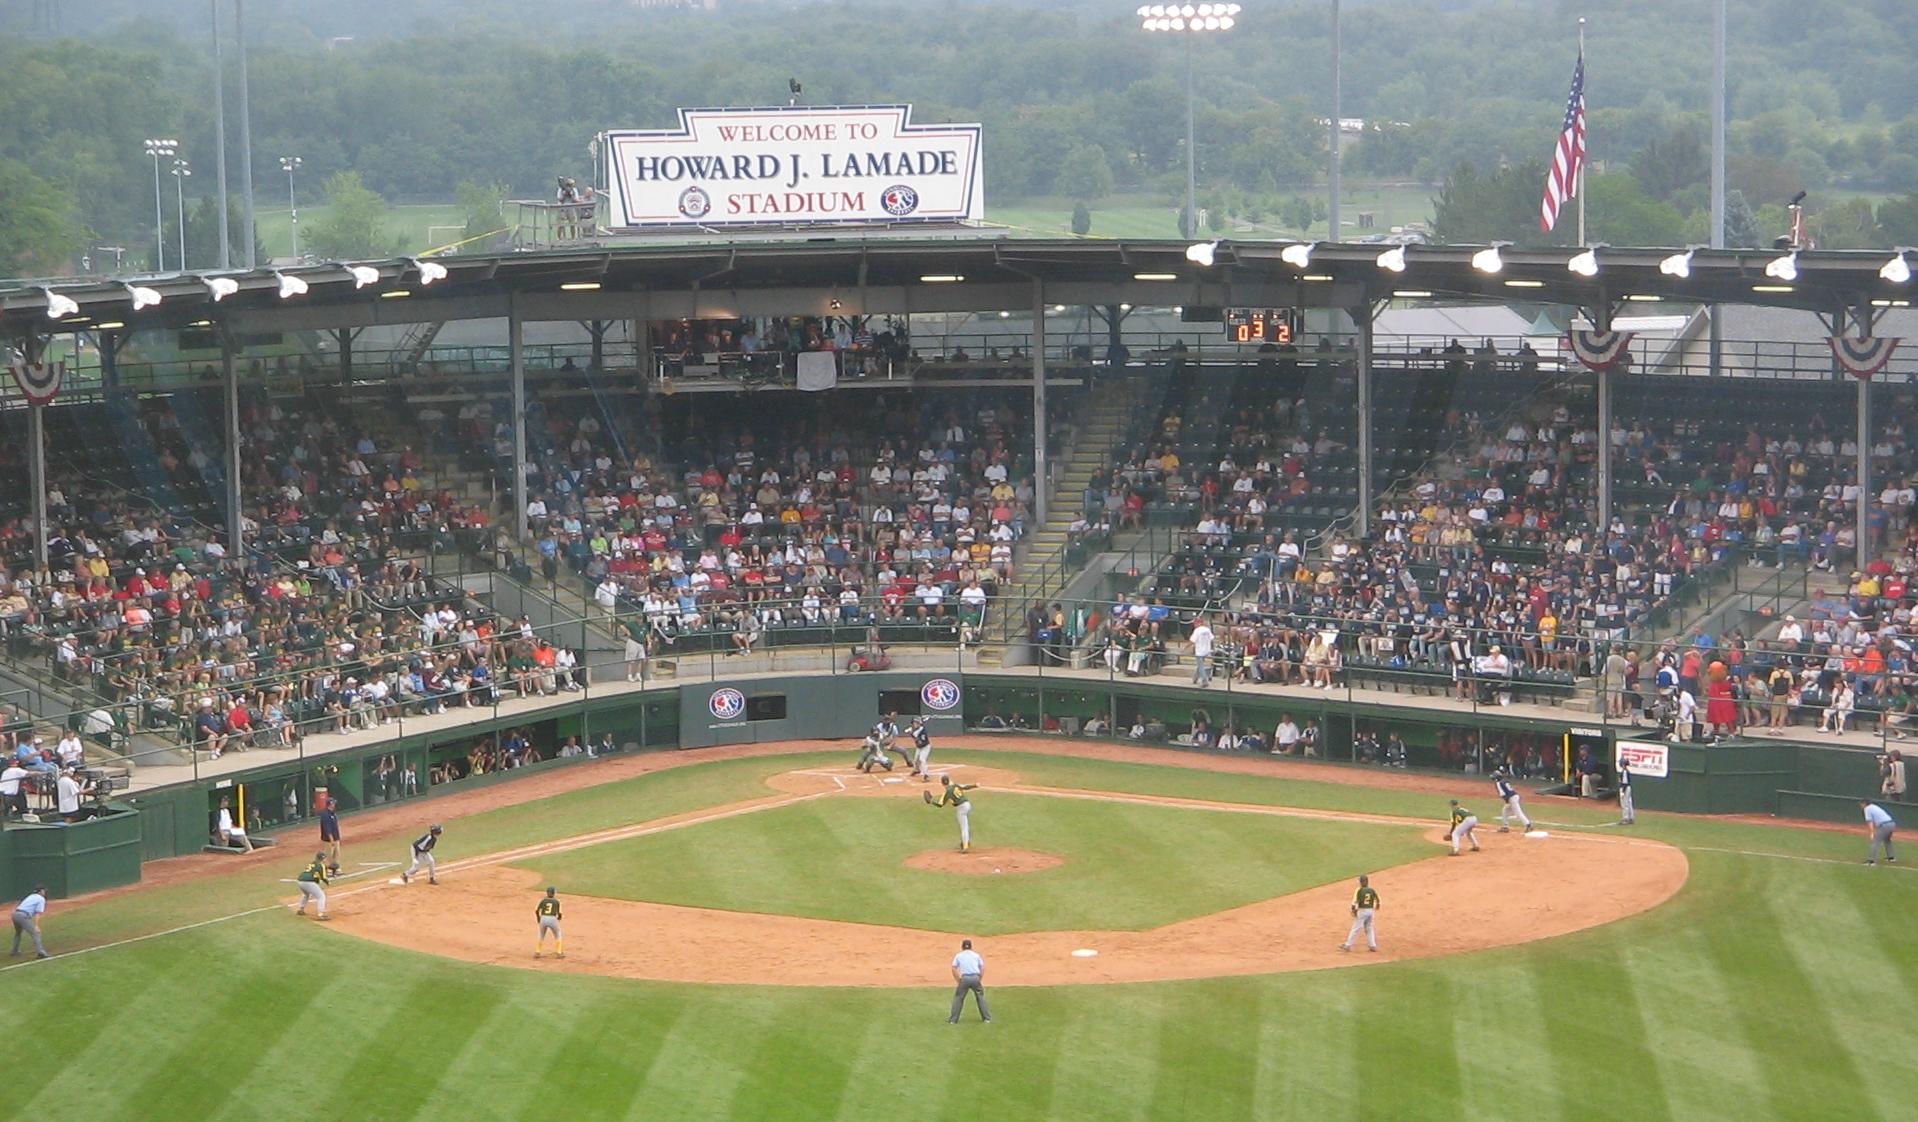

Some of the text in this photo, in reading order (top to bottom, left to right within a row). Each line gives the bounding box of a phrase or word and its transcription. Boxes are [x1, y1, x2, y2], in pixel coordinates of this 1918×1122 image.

[718, 123, 879, 142] WELCOME TO
[636, 150, 958, 188] HOWARD J. LAMADE
[727, 191, 866, 215] STADIUM
[1238, 325, 1249, 341] 0
[1253, 321, 1263, 337] 3
[1279, 325, 1289, 342] 2
[1363, 893, 1371, 905] 2
[545, 902, 553, 914] 3
